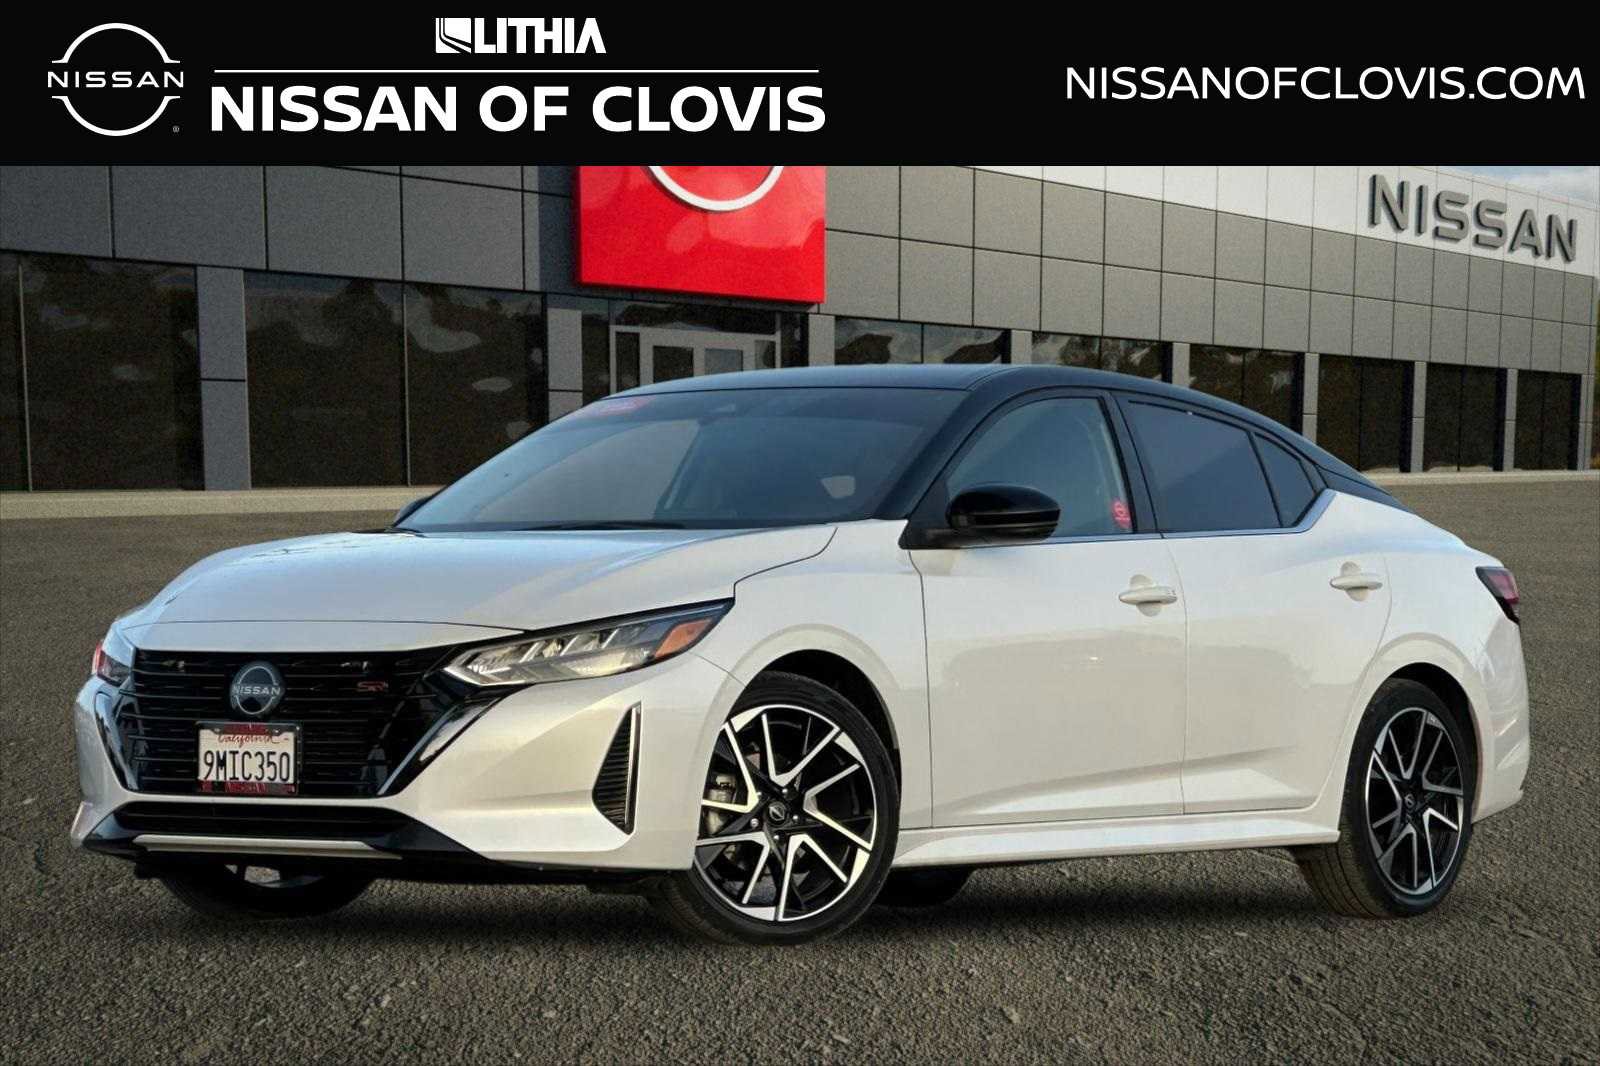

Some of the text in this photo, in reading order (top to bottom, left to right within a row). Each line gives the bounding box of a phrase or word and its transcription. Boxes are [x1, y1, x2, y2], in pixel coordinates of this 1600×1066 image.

[1368, 174, 1577, 263] NISSAN
[231, 686, 281, 696] NISSAN
[204, 750, 290, 782] 9MIC350
